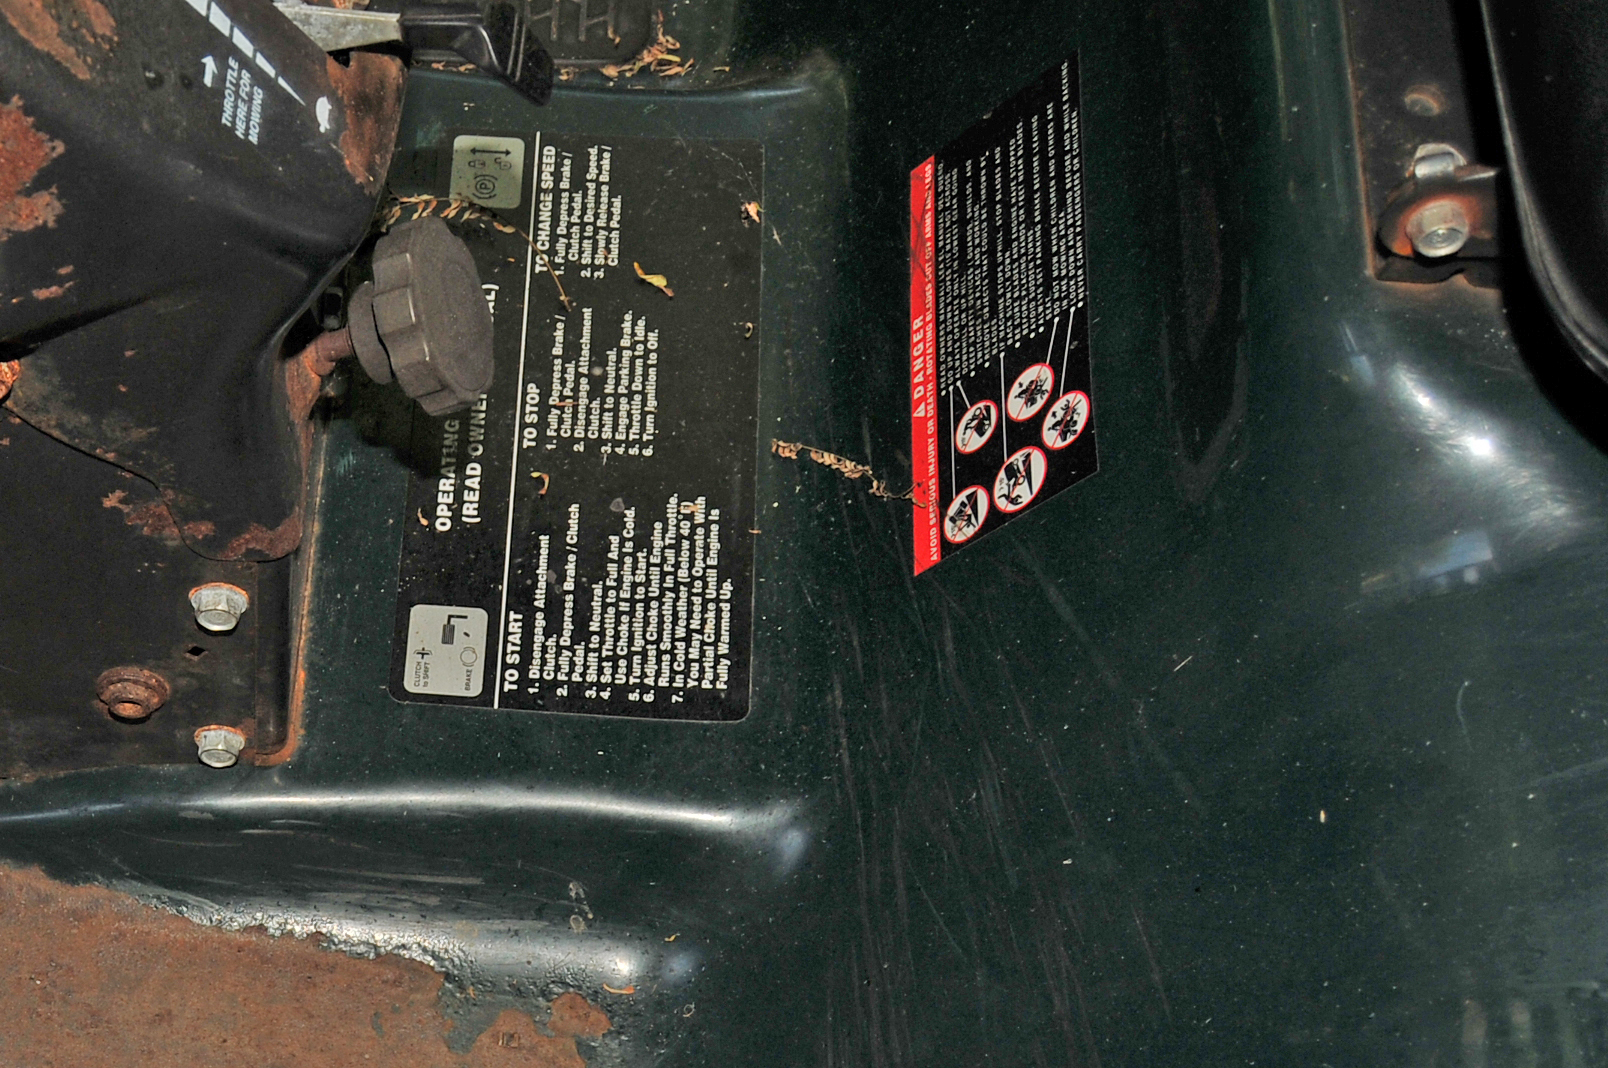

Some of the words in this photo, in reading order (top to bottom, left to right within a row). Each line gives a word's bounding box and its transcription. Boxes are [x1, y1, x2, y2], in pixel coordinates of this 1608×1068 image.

[222, 56, 239, 127] THROTTLE
[239, 69, 251, 100] FOR
[235, 98, 248, 139] HERE
[248, 86, 263, 145] MOWING
[540, 145, 556, 190] SPEED
[559, 158, 572, 189] Brake
[585, 145, 599, 180] Speed.
[598, 151, 611, 182] Brake
[556, 191, 570, 235] Depress
[570, 190, 583, 223] Pedal.
[583, 182, 596, 223] Desired
[596, 184, 610, 227] Release
[609, 195, 622, 228] Pedal.
[536, 192, 553, 251] CHANGE
[583, 224, 594, 237] to
[554, 237, 569, 264] Fully
[567, 225, 581, 261] Clutch
[580, 239, 593, 265] Shift
[593, 229, 609, 265] Slowly
[607, 230, 620, 267] Clutch
[534, 253, 549, 274] TO
[554, 265, 565, 276] 1.
[580, 267, 592, 278] 2.
[593, 267, 605, 280] 3.
[551, 321, 565, 356] Brake
[577, 307, 593, 375] Attachment
[620, 310, 633, 347] Brake.
[633, 316, 646, 341] Idle.
[646, 329, 659, 350] Off.
[633, 343, 645, 356] to
[646, 352, 658, 365] to
[913, 315, 924, 399] DANGER
[548, 358, 563, 405] Depress
[562, 360, 576, 396] Pedal.
[603, 347, 617, 394] Neutral.
[617, 349, 633, 394] Parking
[631, 358, 644, 391] Down
[524, 382, 540, 424] STOP
[603, 396, 615, 409] to
[644, 367, 658, 412] Ignition
[546, 407, 561, 436] Fully
[560, 398, 573, 438] Clutch
[573, 376, 590, 438] Disengage
[587, 397, 601, 439] Clutch.
[614, 396, 630, 440] Engage
[628, 393, 642, 441] Throttle
[522, 427, 538, 449] TO
[601, 411, 614, 440] Shift
[642, 414, 655, 442] Turn
[928, 419, 934, 434] OR
[545, 439, 557, 450] 1.
[573, 441, 585, 452] 2.
[600, 442, 612, 454] 3.
[614, 443, 626, 455] 4.
[628, 444, 640, 456] 5.
[641, 444, 654, 457] 6.
[435, 418, 460, 532] OPERATING
[461, 462, 482, 523] (READ
[565, 503, 580, 544] Clutch
[622, 506, 636, 538] Cold.
[664, 493, 679, 546] Throttle.
[693, 496, 706, 524] With
[708, 508, 720, 521] Is
[607, 535, 620, 561] And
[621, 540, 634, 553] Is
[649, 521, 664, 564] Engine
[691, 526, 706, 577] Operate
[706, 523, 721, 566] Engine
[930, 527, 938, 560] AVOID
[533, 534, 550, 609] Attachment
[562, 553, 577, 591] Brake
[606, 563, 619, 587] Full
[634, 548, 648, 583] Start.
[663, 548, 676, 572] Full
[677, 539, 691, 583] (Below
[619, 555, 634, 599] Engine
[634, 586, 646, 600] to
[648, 566, 661, 597] Until
[662, 575, 675, 588] In
[691, 579, 703, 593] to
[705, 568, 718, 599] Until
[719, 578, 734, 600] Up.
[589, 580, 603, 632] Neutral.
[605, 589, 617, 603] to
[618, 601, 631, 612] If
[674, 584, 688, 639] Weather
[559, 593, 575, 646] Depress
[631, 602, 645, 652] Ignition
[646, 600, 660, 641] Choke
[660, 590, 676, 651] Smoothly
[689, 596, 703, 630] Need
[703, 602, 717, 643] Choke
[717, 602, 731, 655] Warmed
[505, 610, 523, 665] START
[528, 611, 546, 679] Disengage
[588, 634, 600, 649] to
[602, 606, 616, 658] Throttle
[616, 614, 630, 656] Choke
[688, 632, 703, 660] May
[543, 633, 557, 680] Clutch.
[557, 649, 573, 681] Fully
[571, 641, 585, 682] Pedal.
[586, 651, 599, 683] Shift
[600, 661, 613, 684] Set
[615, 658, 628, 684] Use
[629, 654, 642, 685] Turn
[644, 644, 660, 687] Adjust
[658, 653, 671, 687] Runs
[673, 641, 686, 672] Cold
[701, 645, 715, 689] Partial
[414, 661, 422, 687] CLUTCH
[464, 668, 473, 691] BRAKE
[503, 668, 519, 692] TO
[527, 682, 540, 694] 1.
[672, 674, 685, 688] In
[687, 662, 700, 689] You
[716, 657, 731, 690] Fully
[556, 684, 568, 697] 2.
[585, 686, 597, 699] 3.
[600, 687, 612, 700] 4.
[628, 688, 640, 701] 5.
[643, 689, 655, 703] 6.
[672, 691, 684, 703] 7.
